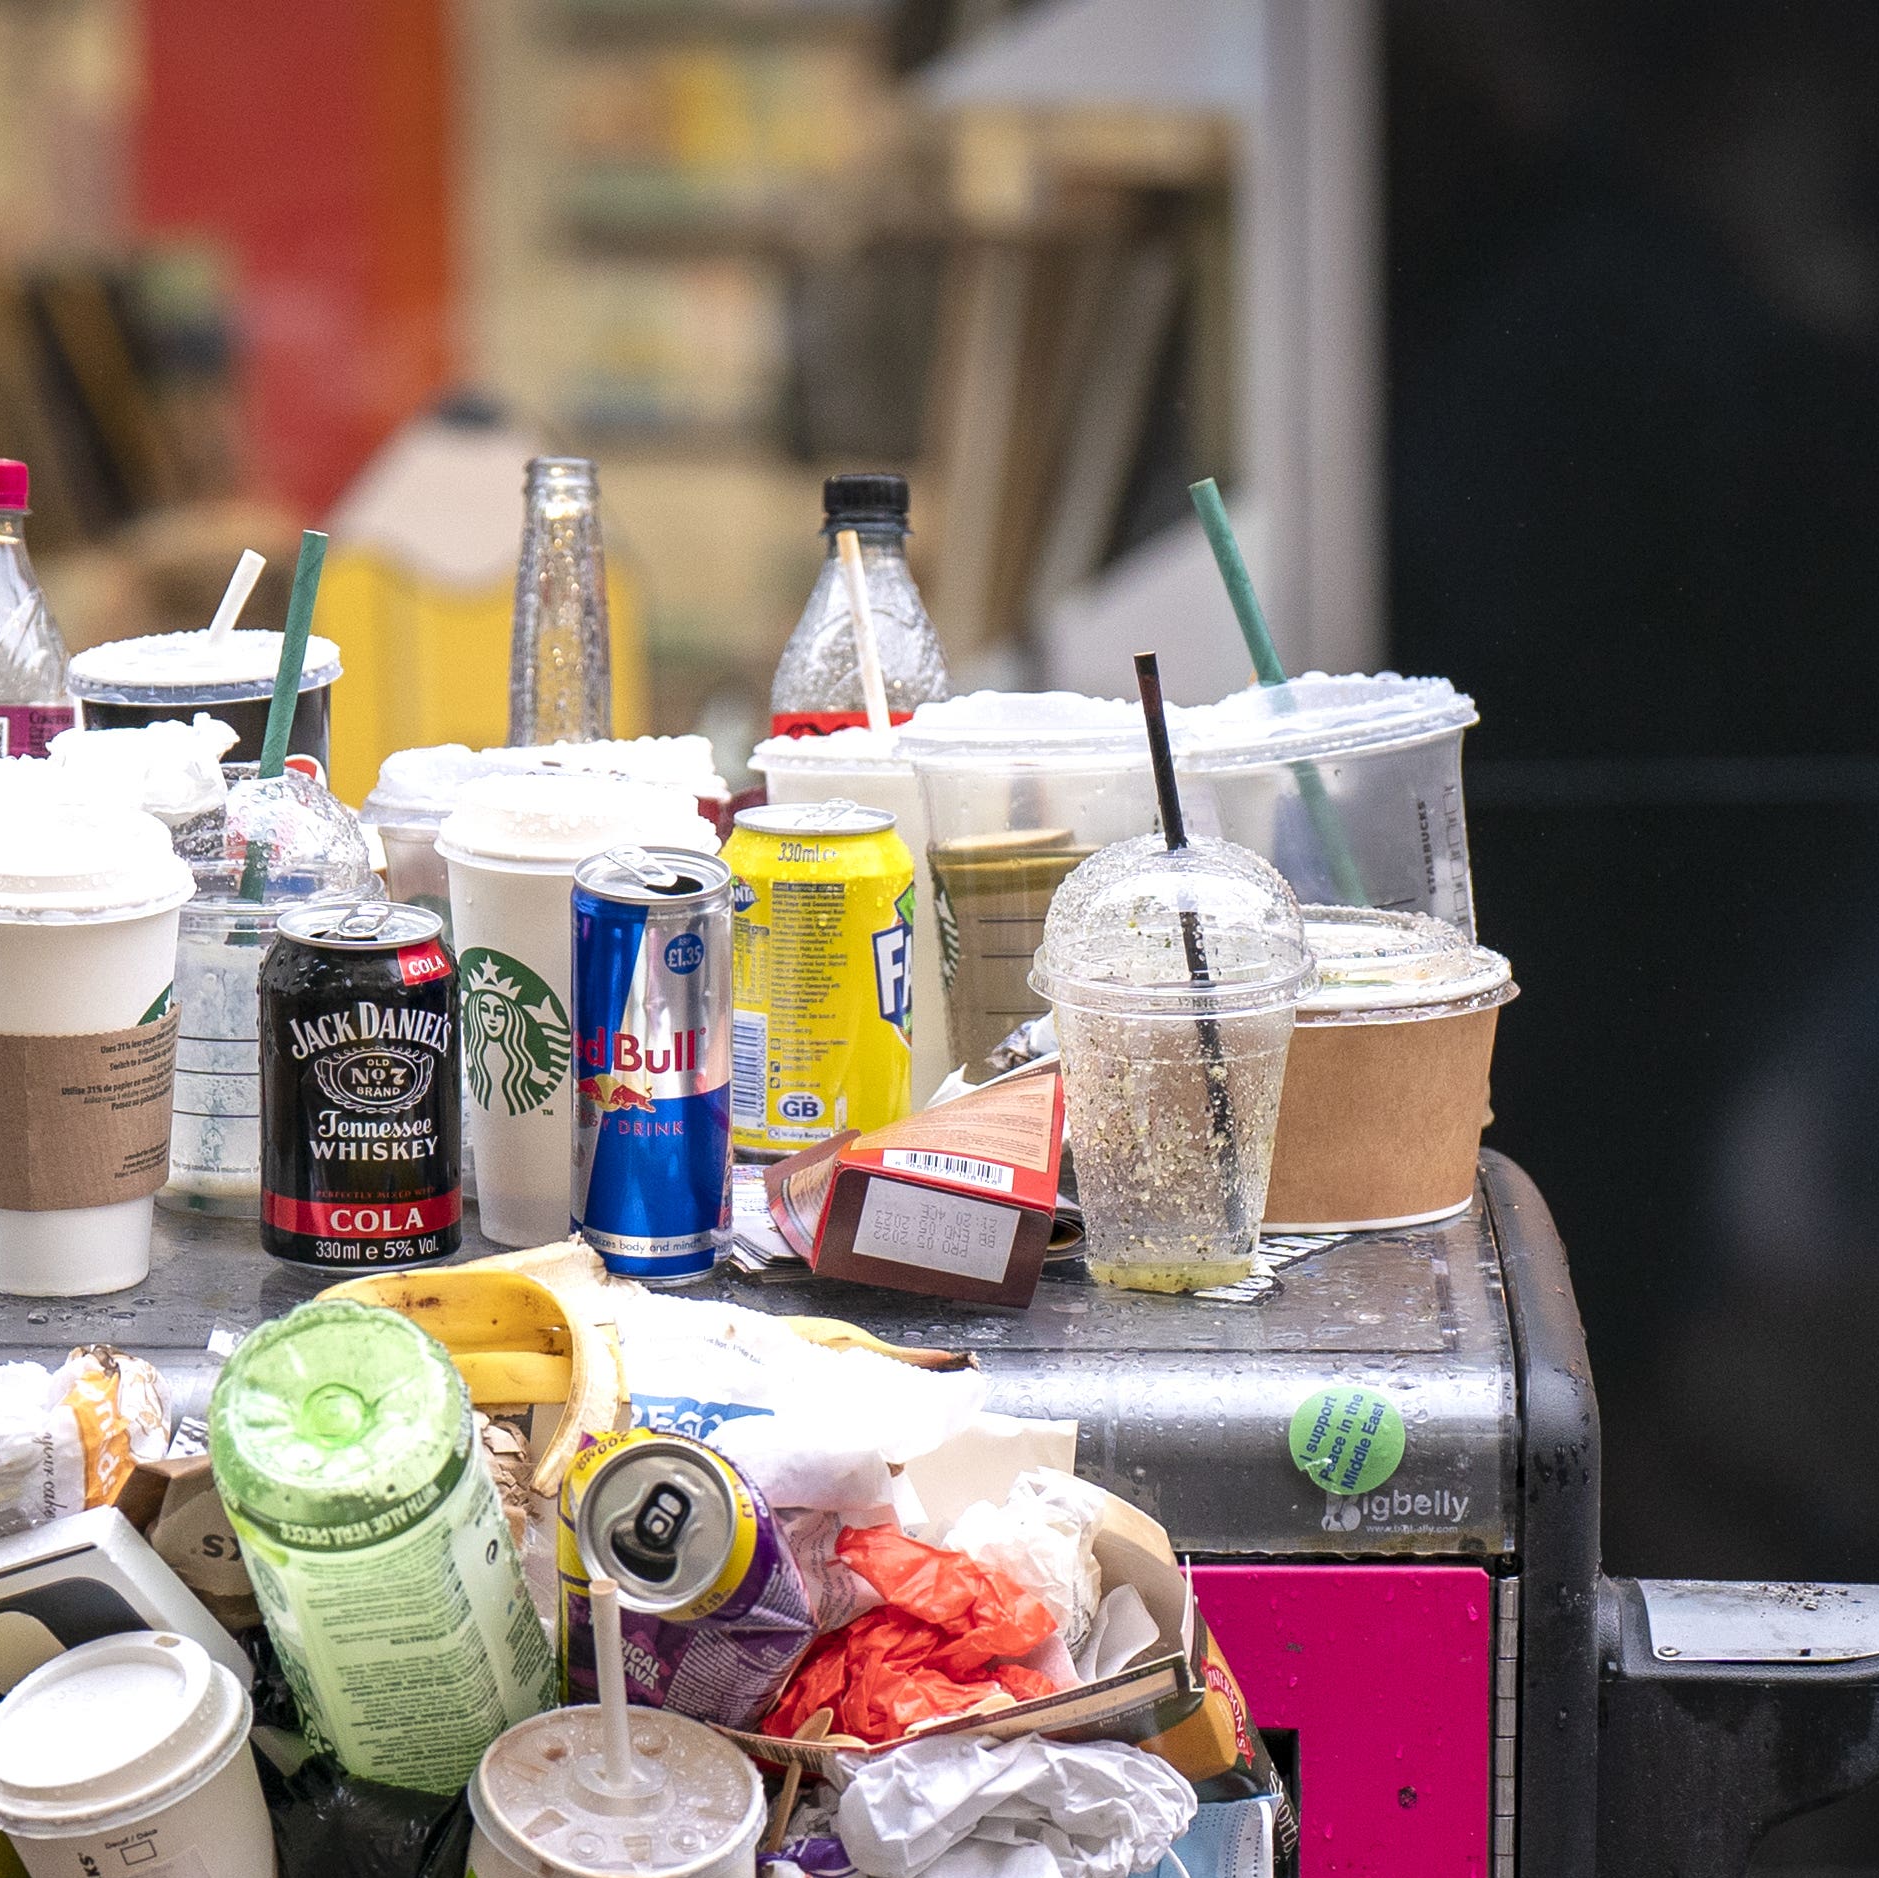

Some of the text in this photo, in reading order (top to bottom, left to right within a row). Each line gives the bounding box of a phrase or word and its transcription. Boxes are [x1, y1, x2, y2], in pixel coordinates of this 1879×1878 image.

[409, 955, 445, 977] COLA
[668, 945, 701, 967] £1.35
[289, 1002, 453, 1060] JACK DANIEL'S
[367, 1058, 390, 1067] OLD
[573, 1026, 696, 1074] ed Bull
[390, 1068, 407, 1085] 7
[356, 1086, 400, 1097] BRAND
[783, 1100, 818, 1117] GB
[318, 1110, 433, 1138] Tennessee
[618, 1119, 684, 1136] DRINK
[309, 1135, 439, 1161] WHISKEY
[330, 1207, 424, 1232] COLA
[315, 1240, 360, 1260] 330ml
[384, 1239, 414, 1259] 5%
[418, 1236, 439, 1255] Vol.
[619, 1239, 645, 1255] body
[650, 1241, 669, 1253] and
[1299, 1395, 1337, 1462] I support
[1318, 1394, 1364, 1483] Peace in the
[1340, 1402, 1386, 1490] Middle East
[408, 1482, 442, 1515] WITH
[372, 1504, 409, 1537] ALOE
[333, 1523, 372, 1546] VERA
[1206, 1664, 1247, 1748] PATERSON'S
